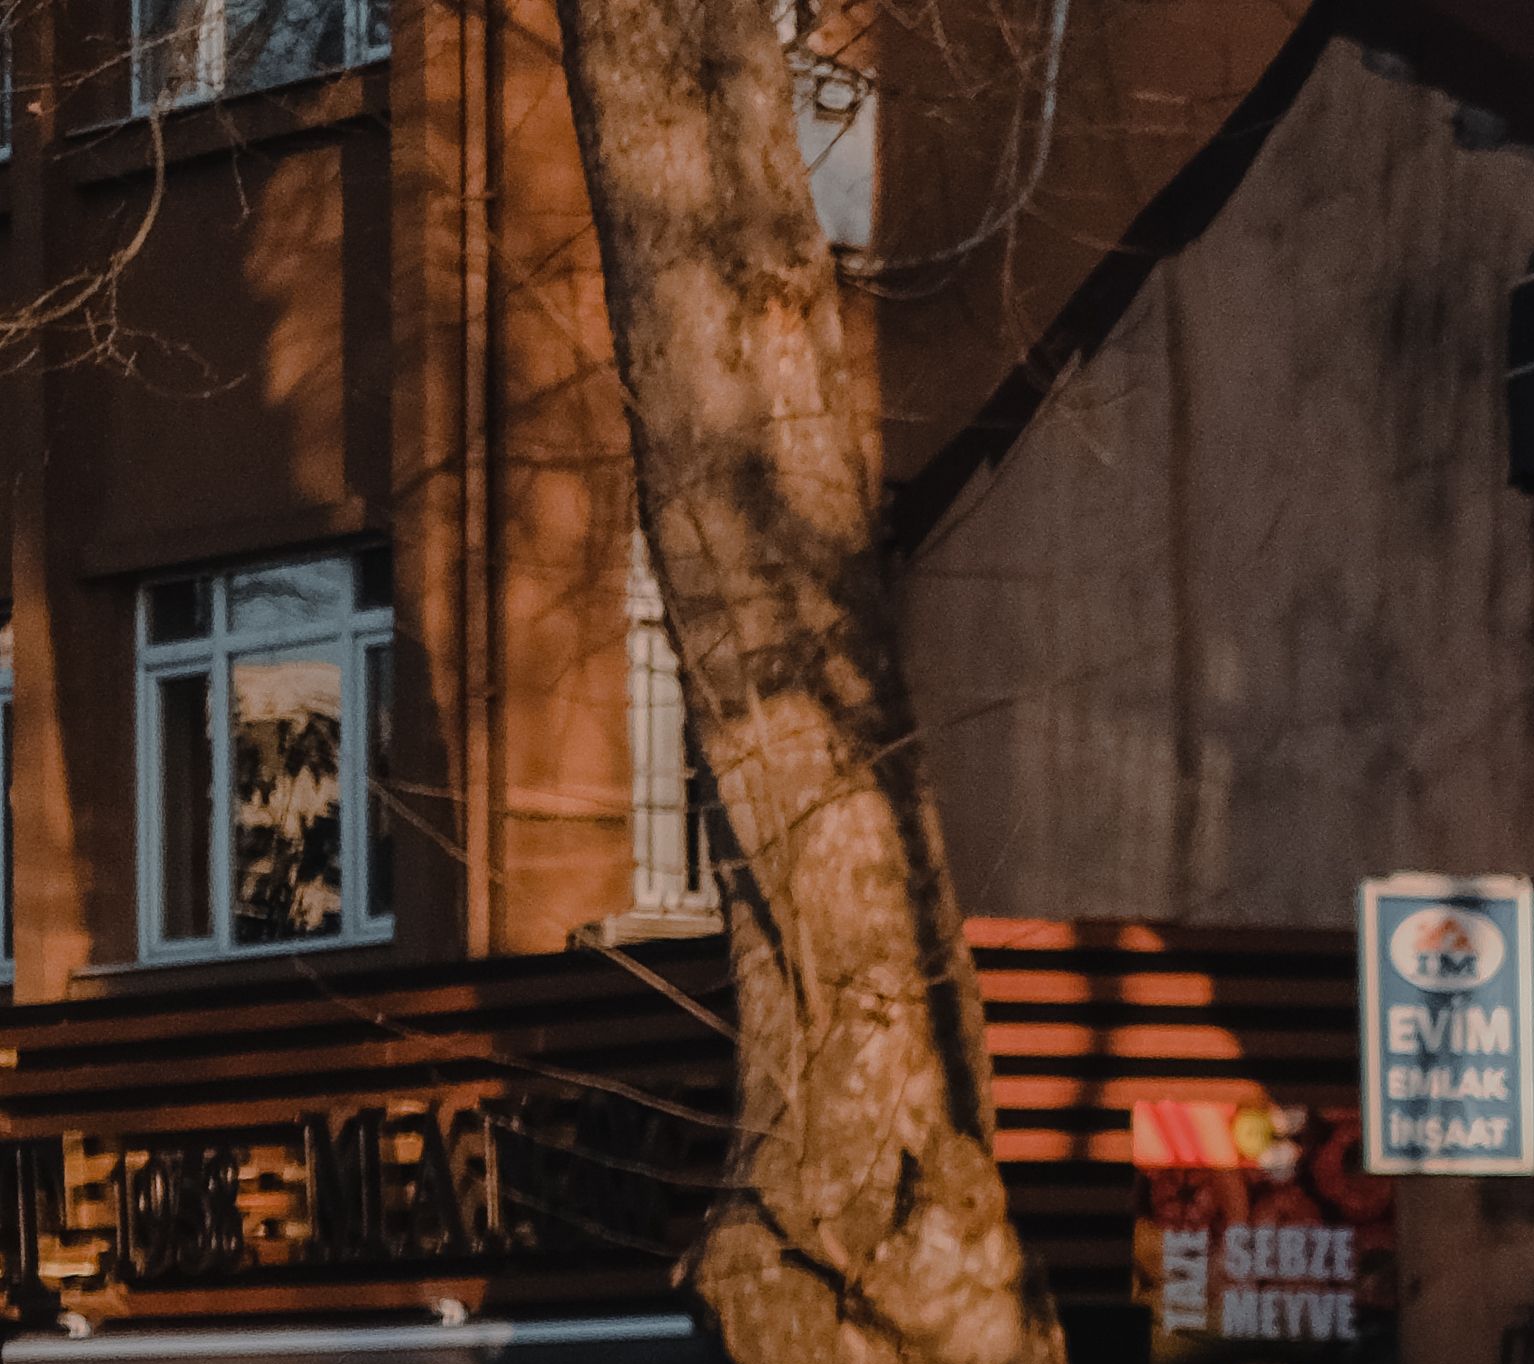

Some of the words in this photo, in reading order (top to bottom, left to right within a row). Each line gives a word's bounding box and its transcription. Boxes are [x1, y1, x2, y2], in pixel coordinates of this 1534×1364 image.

[1387, 997, 1512, 1056] EVİM
[1387, 1066, 1509, 1102] EMLAK
[1389, 1106, 1511, 1153] İNŞAAT
[1223, 1223, 1356, 1280] SEBZE
[1221, 1287, 1360, 1341] MEYVE
